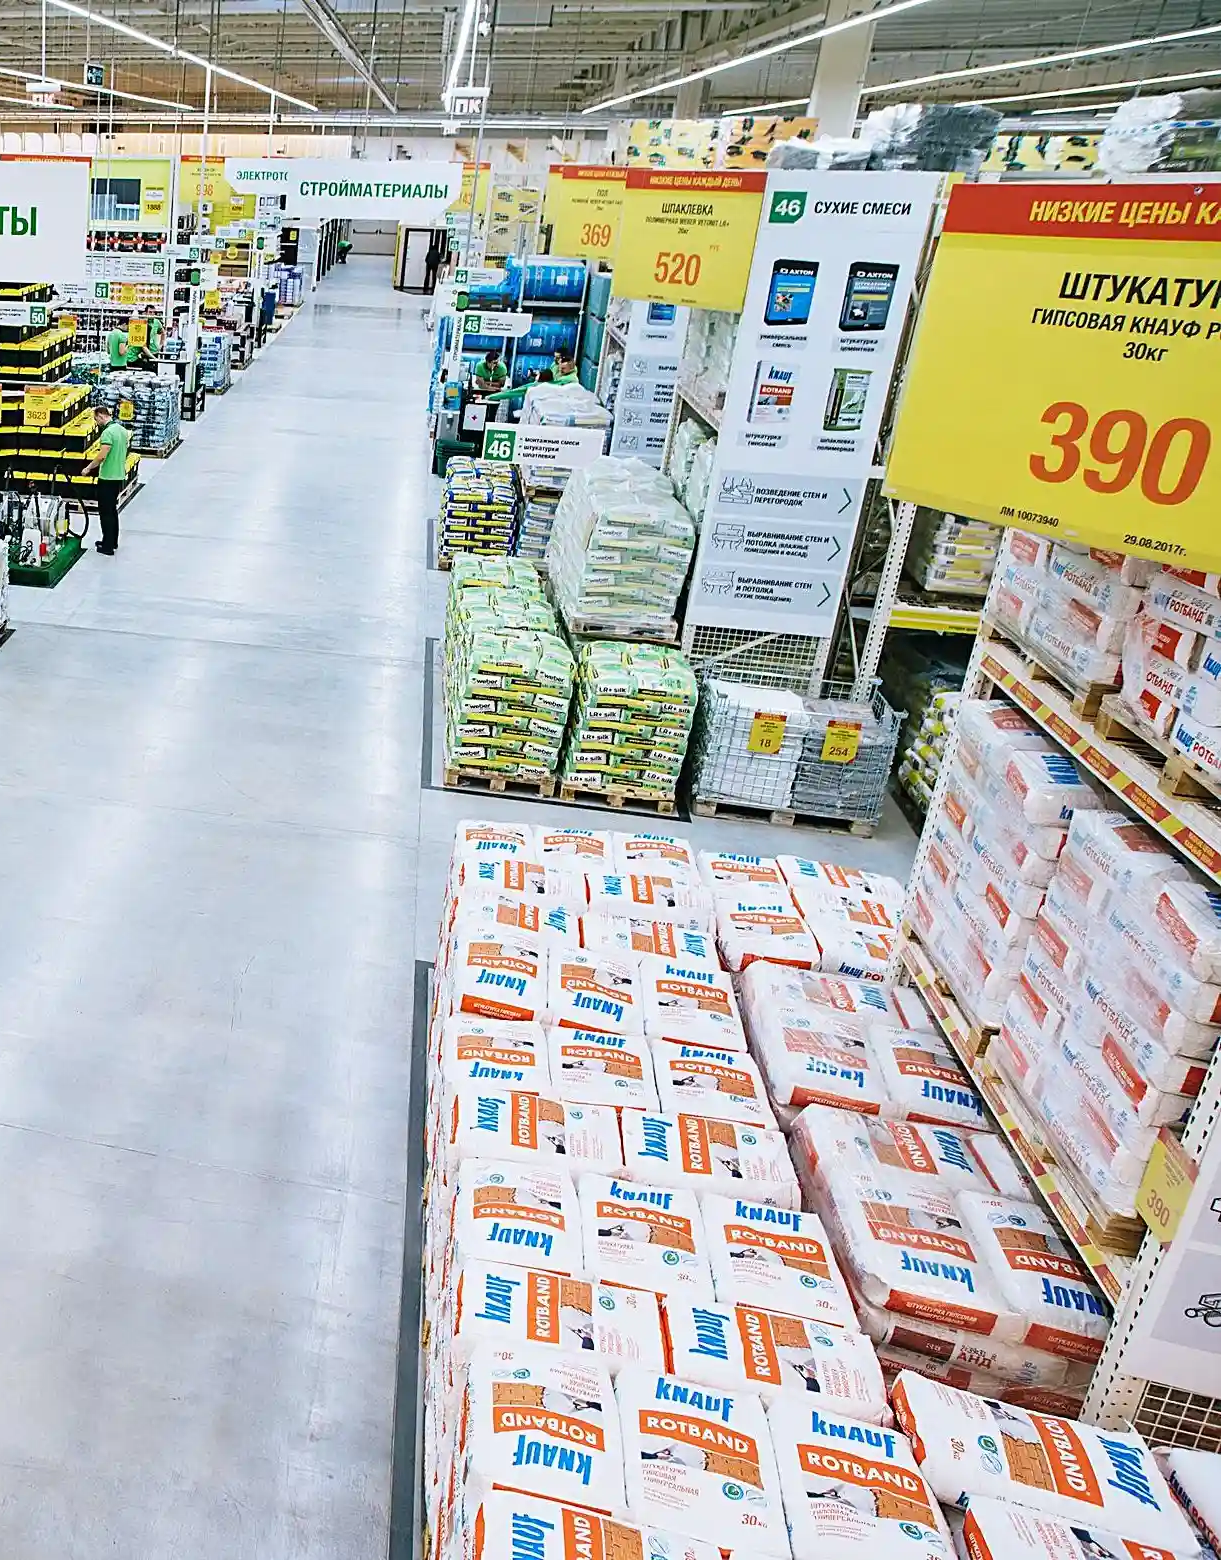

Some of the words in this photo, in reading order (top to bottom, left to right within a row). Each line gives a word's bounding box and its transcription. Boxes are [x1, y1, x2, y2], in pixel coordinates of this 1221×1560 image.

[299, 179, 448, 199] СТРОЙМАТЕРИАЛЫ
[650, 176, 674, 186] НИЗКИЕ
[675, 176, 693, 188] ЦЕНЫ
[693, 177, 722, 188] КАЖДЫЙ
[662, 203, 713, 216] ШПАКЛЕВКА
[775, 199, 800, 215] 46
[814, 201, 858, 216] СУХИЕ
[863, 202, 912, 216] СМЕСИ
[1029, 200, 1116, 223] НИЗКИЕ
[1119, 200, 1190, 229] ЦЕНЫ
[581, 223, 611, 247] 369
[654, 252, 701, 286] 520
[456, 274, 466, 282] 44
[96, 288, 107, 297] 51
[32, 313, 44, 324] 50
[465, 321, 479, 331] 45
[1031, 308, 1126, 332] ГИПСОВАЯ
[1130, 316, 1201, 340] КНАУФ
[760, 334, 807, 342] универсальная
[840, 338, 878, 346] штукатурка
[1123, 342, 1168, 362] 30кг
[768, 366, 793, 384] KNAUF
[762, 387, 793, 395] ROTBAND
[27, 411, 47, 420] 3623
[745, 433, 782, 441] штукатурка
[487, 441, 510, 458] 46
[1029, 401, 1212, 506] 390
[756, 488, 801, 498] ВОЗВЕДЕНИЕ
[754, 497, 803, 507] ПЕРЕГОРОДОК
[1000, 506, 1014, 517] ЛМ
[1017, 509, 1059, 528] 10073940
[745, 539, 777, 548] ПОТОЛКА
[747, 531, 803, 542] ВЫРАВНИВАНИЕ
[1123, 533, 1188, 557] 29.08.2017г.
[738, 577, 793, 588] ВЫРАВНИВАНИЕ
[1062, 569, 1092, 593] РОТБАНД
[743, 586, 773, 594] ПОТОЛКА
[1168, 598, 1205, 625] РОТБАНД
[474, 676, 498, 686] weber
[544, 670, 565, 683] weber
[599, 685, 613, 693] LR+
[614, 685, 627, 693] silk
[542, 699, 565, 708] weber
[589, 710, 603, 719] LR+
[604, 710, 616, 718] silk
[760, 739, 771, 748] 18
[829, 747, 849, 757] 254
[665, 965, 715, 985] KNAUF
[662, 982, 727, 1000] ROTBAND
[735, 1199, 802, 1233] KNAUF
[1143, 1187, 1172, 1229] 390
[730, 1229, 819, 1255] ROTBAND
[475, 1273, 521, 1324] KNAUF
[537, 1276, 551, 1338] ROTBAND
[655, 1377, 734, 1422] KNAUF
[501, 1412, 598, 1445] ROTBAND
[647, 1416, 749, 1453] ROTBAND
[811, 1411, 898, 1459] KNAUF
[512, 1434, 593, 1486] KNAUF
[1042, 1417, 1088, 1494] ROTBAND
[806, 1451, 919, 1493] ROTBAND
[1096, 1435, 1162, 1512] KNAUF
